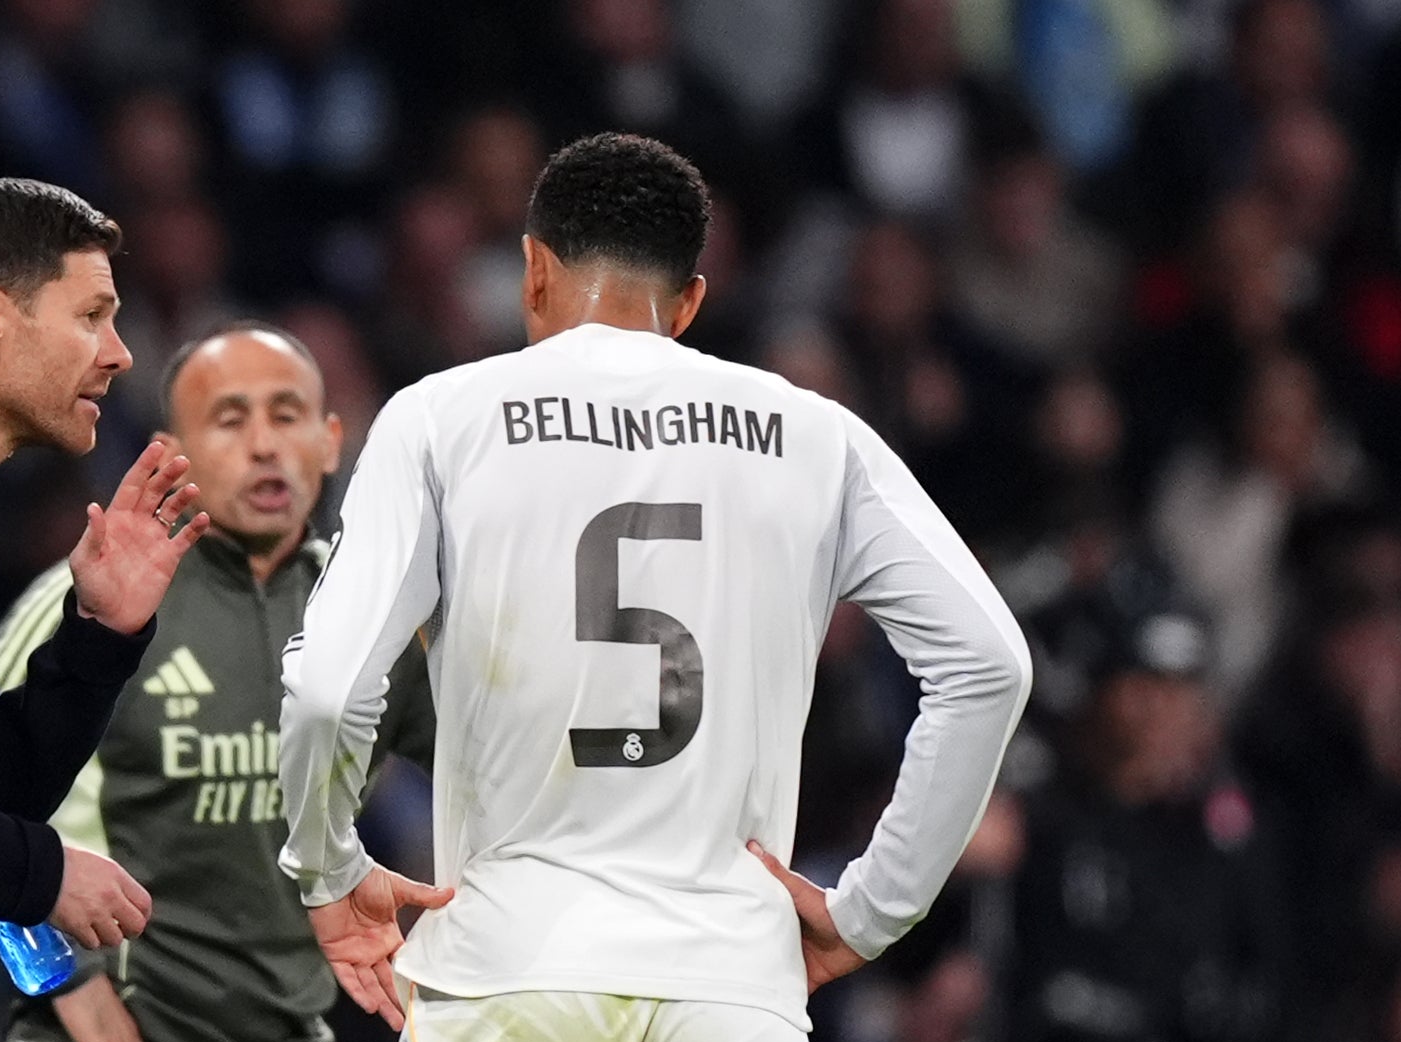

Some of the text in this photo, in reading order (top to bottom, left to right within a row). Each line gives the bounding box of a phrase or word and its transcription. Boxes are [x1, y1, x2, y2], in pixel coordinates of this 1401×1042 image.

[502, 396, 784, 458] BELLINGHAM
[568, 501, 704, 768] 5
[193, 780, 248, 823] FLY
